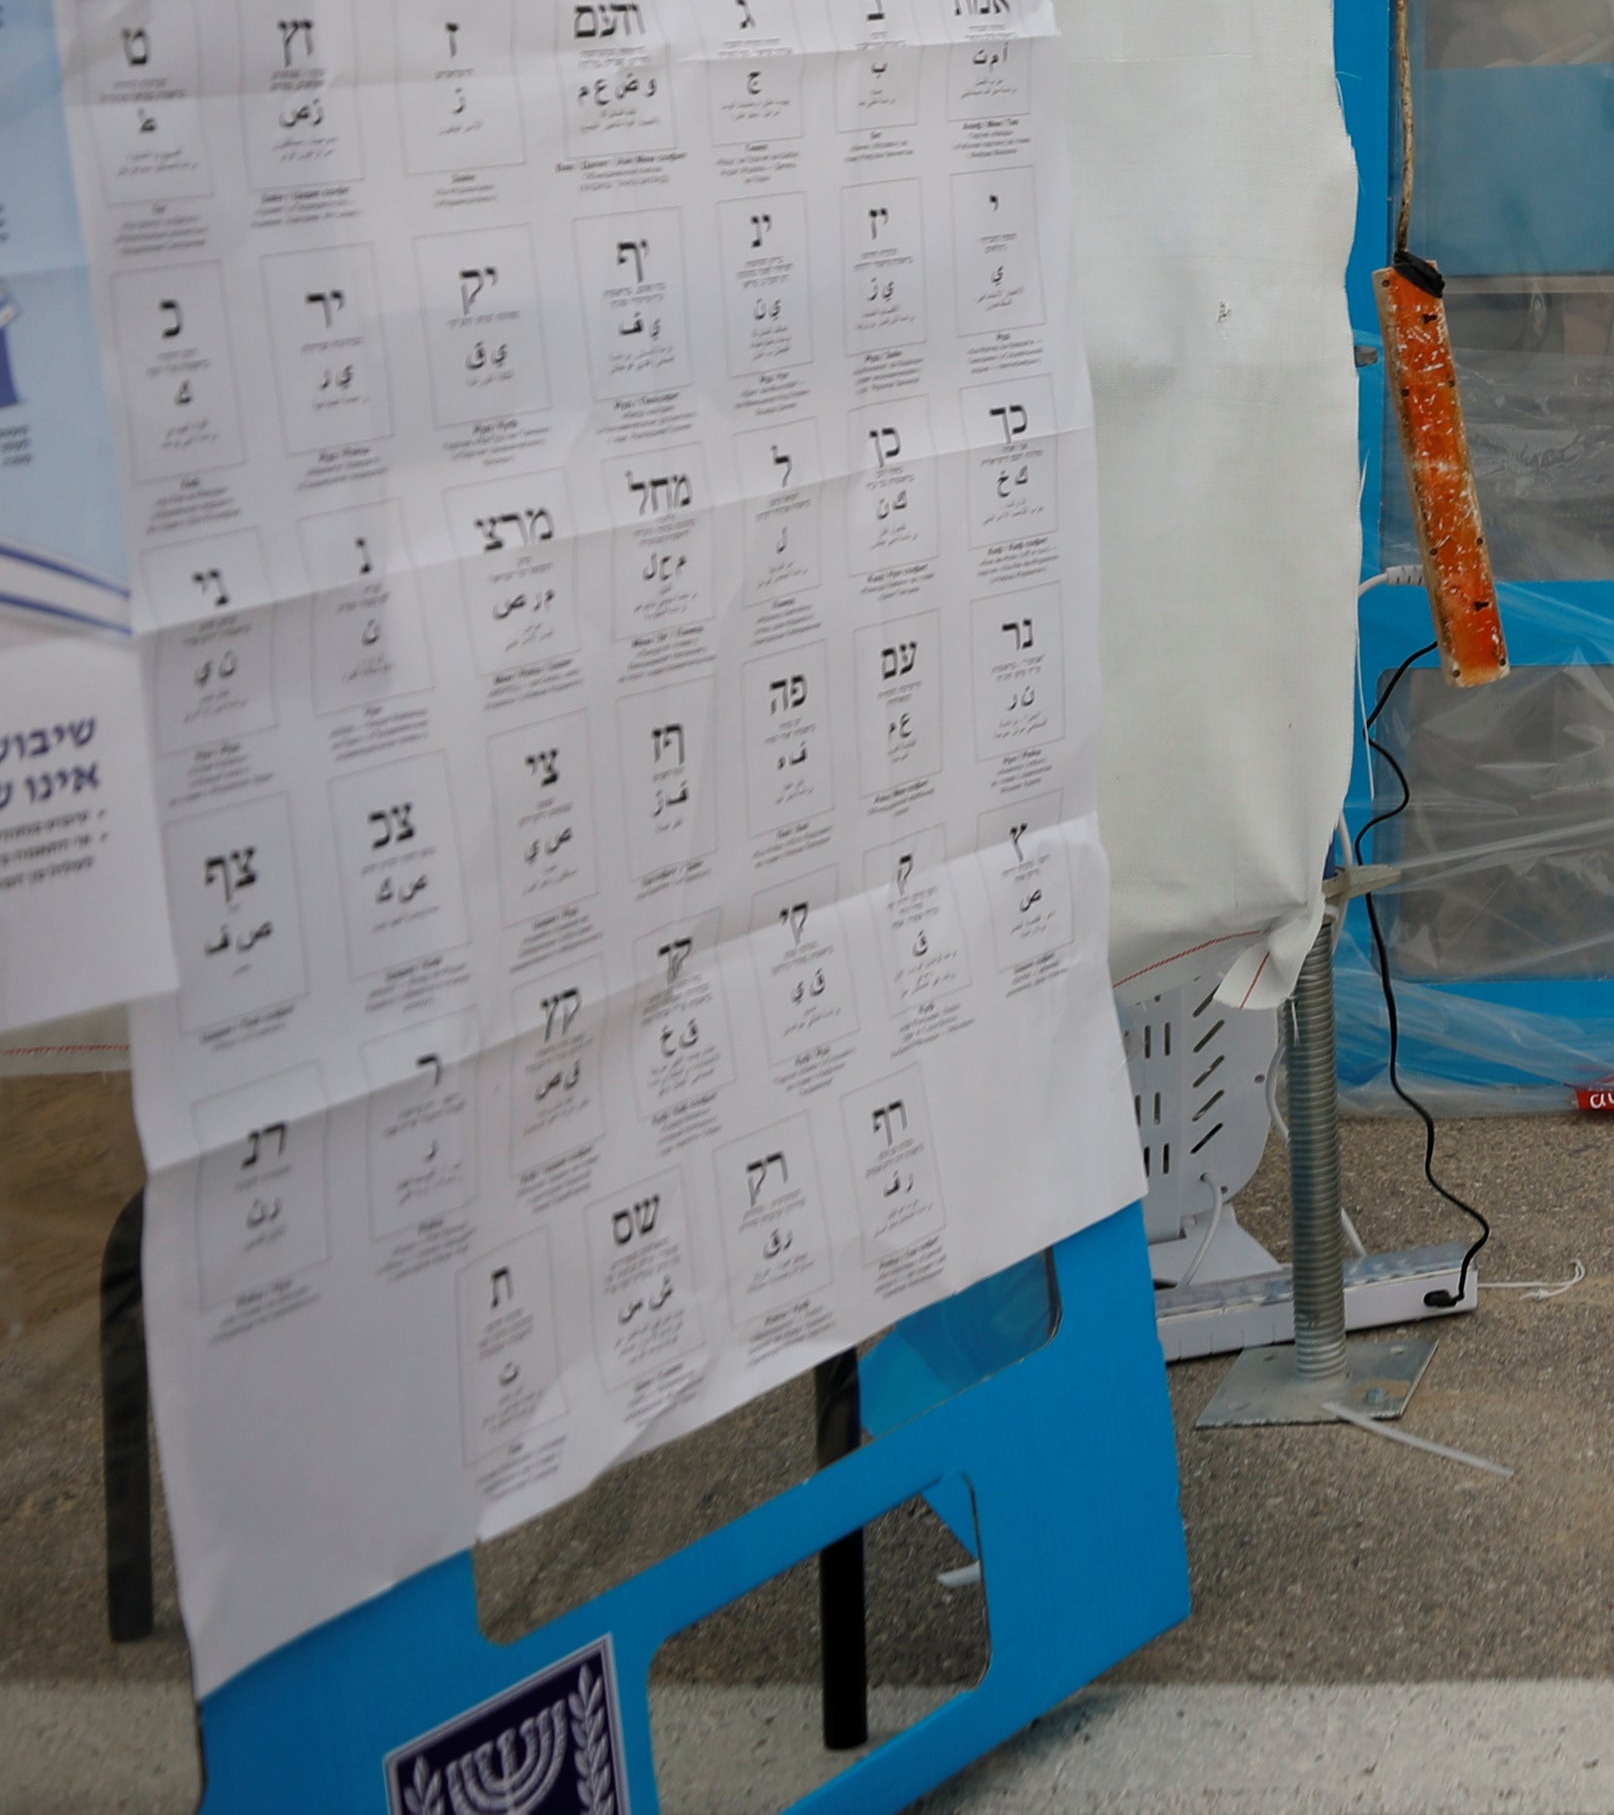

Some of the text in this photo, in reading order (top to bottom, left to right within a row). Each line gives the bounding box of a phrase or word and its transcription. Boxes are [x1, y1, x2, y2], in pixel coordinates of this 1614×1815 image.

[122, 28, 149, 66] ט
[277, 19, 313, 71] זץ
[446, 23, 459, 56] ז
[990, 195, 998, 210] י
[751, 215, 770, 248] ינ
[869, 208, 888, 239] יז
[617, 240, 650, 287] יף
[460, 267, 501, 320] יק
[160, 300, 181, 338] כ
[990, 405, 1027, 447] כך
[772, 446, 791, 486] ל
[869, 427, 900, 472] כן
[626, 472, 691, 513] מחל
[475, 508, 553, 552] מרצ
[356, 538, 372, 574] נ
[192, 569, 230, 606] ני
[1002, 619, 1033, 649] נר
[882, 642, 917, 680] עם
[770, 675, 806, 714] פה
[24, 762, 100, 804] אינו
[526, 749, 558, 787] צי
[368, 803, 415, 849] צכ
[1010, 823, 1030, 865] ץ
[205, 847, 257, 903] צף
[897, 854, 912, 894] ק
[779, 901, 809, 944] קי
[541, 988, 585, 1046] קץ
[417, 1054, 444, 1087] ר
[872, 1100, 906, 1145] רף
[746, 1152, 787, 1206] רק
[612, 1195, 660, 1246] שס
[491, 1267, 510, 1308] ת
